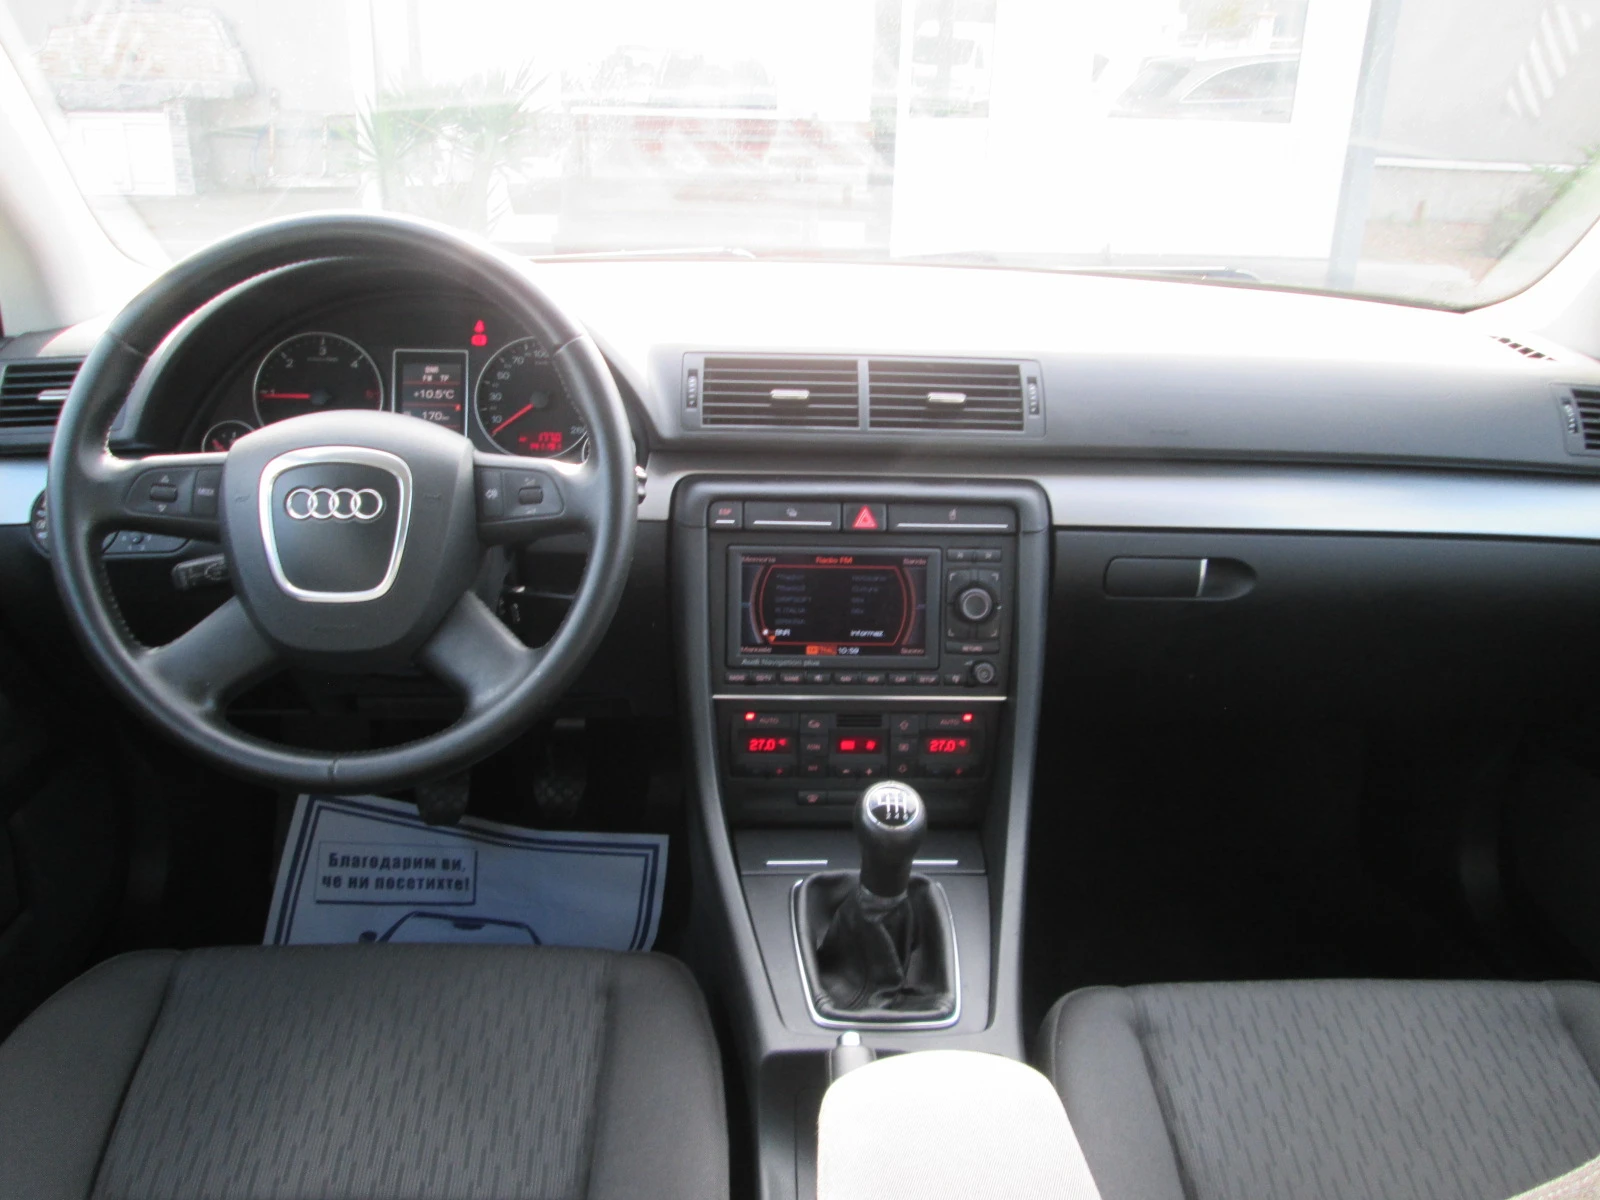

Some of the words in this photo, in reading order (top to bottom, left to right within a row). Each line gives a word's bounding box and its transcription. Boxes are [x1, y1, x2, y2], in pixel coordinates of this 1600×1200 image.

[491, 415, 503, 424] 10
[815, 556, 839, 564] Radio
[840, 556, 853, 564] FM
[328, 852, 436, 870] Благодарим
[441, 858, 466, 872] ви,
[322, 875, 343, 888] че
[347, 876, 370, 890] ни
[374, 877, 471, 891] посетихте!
